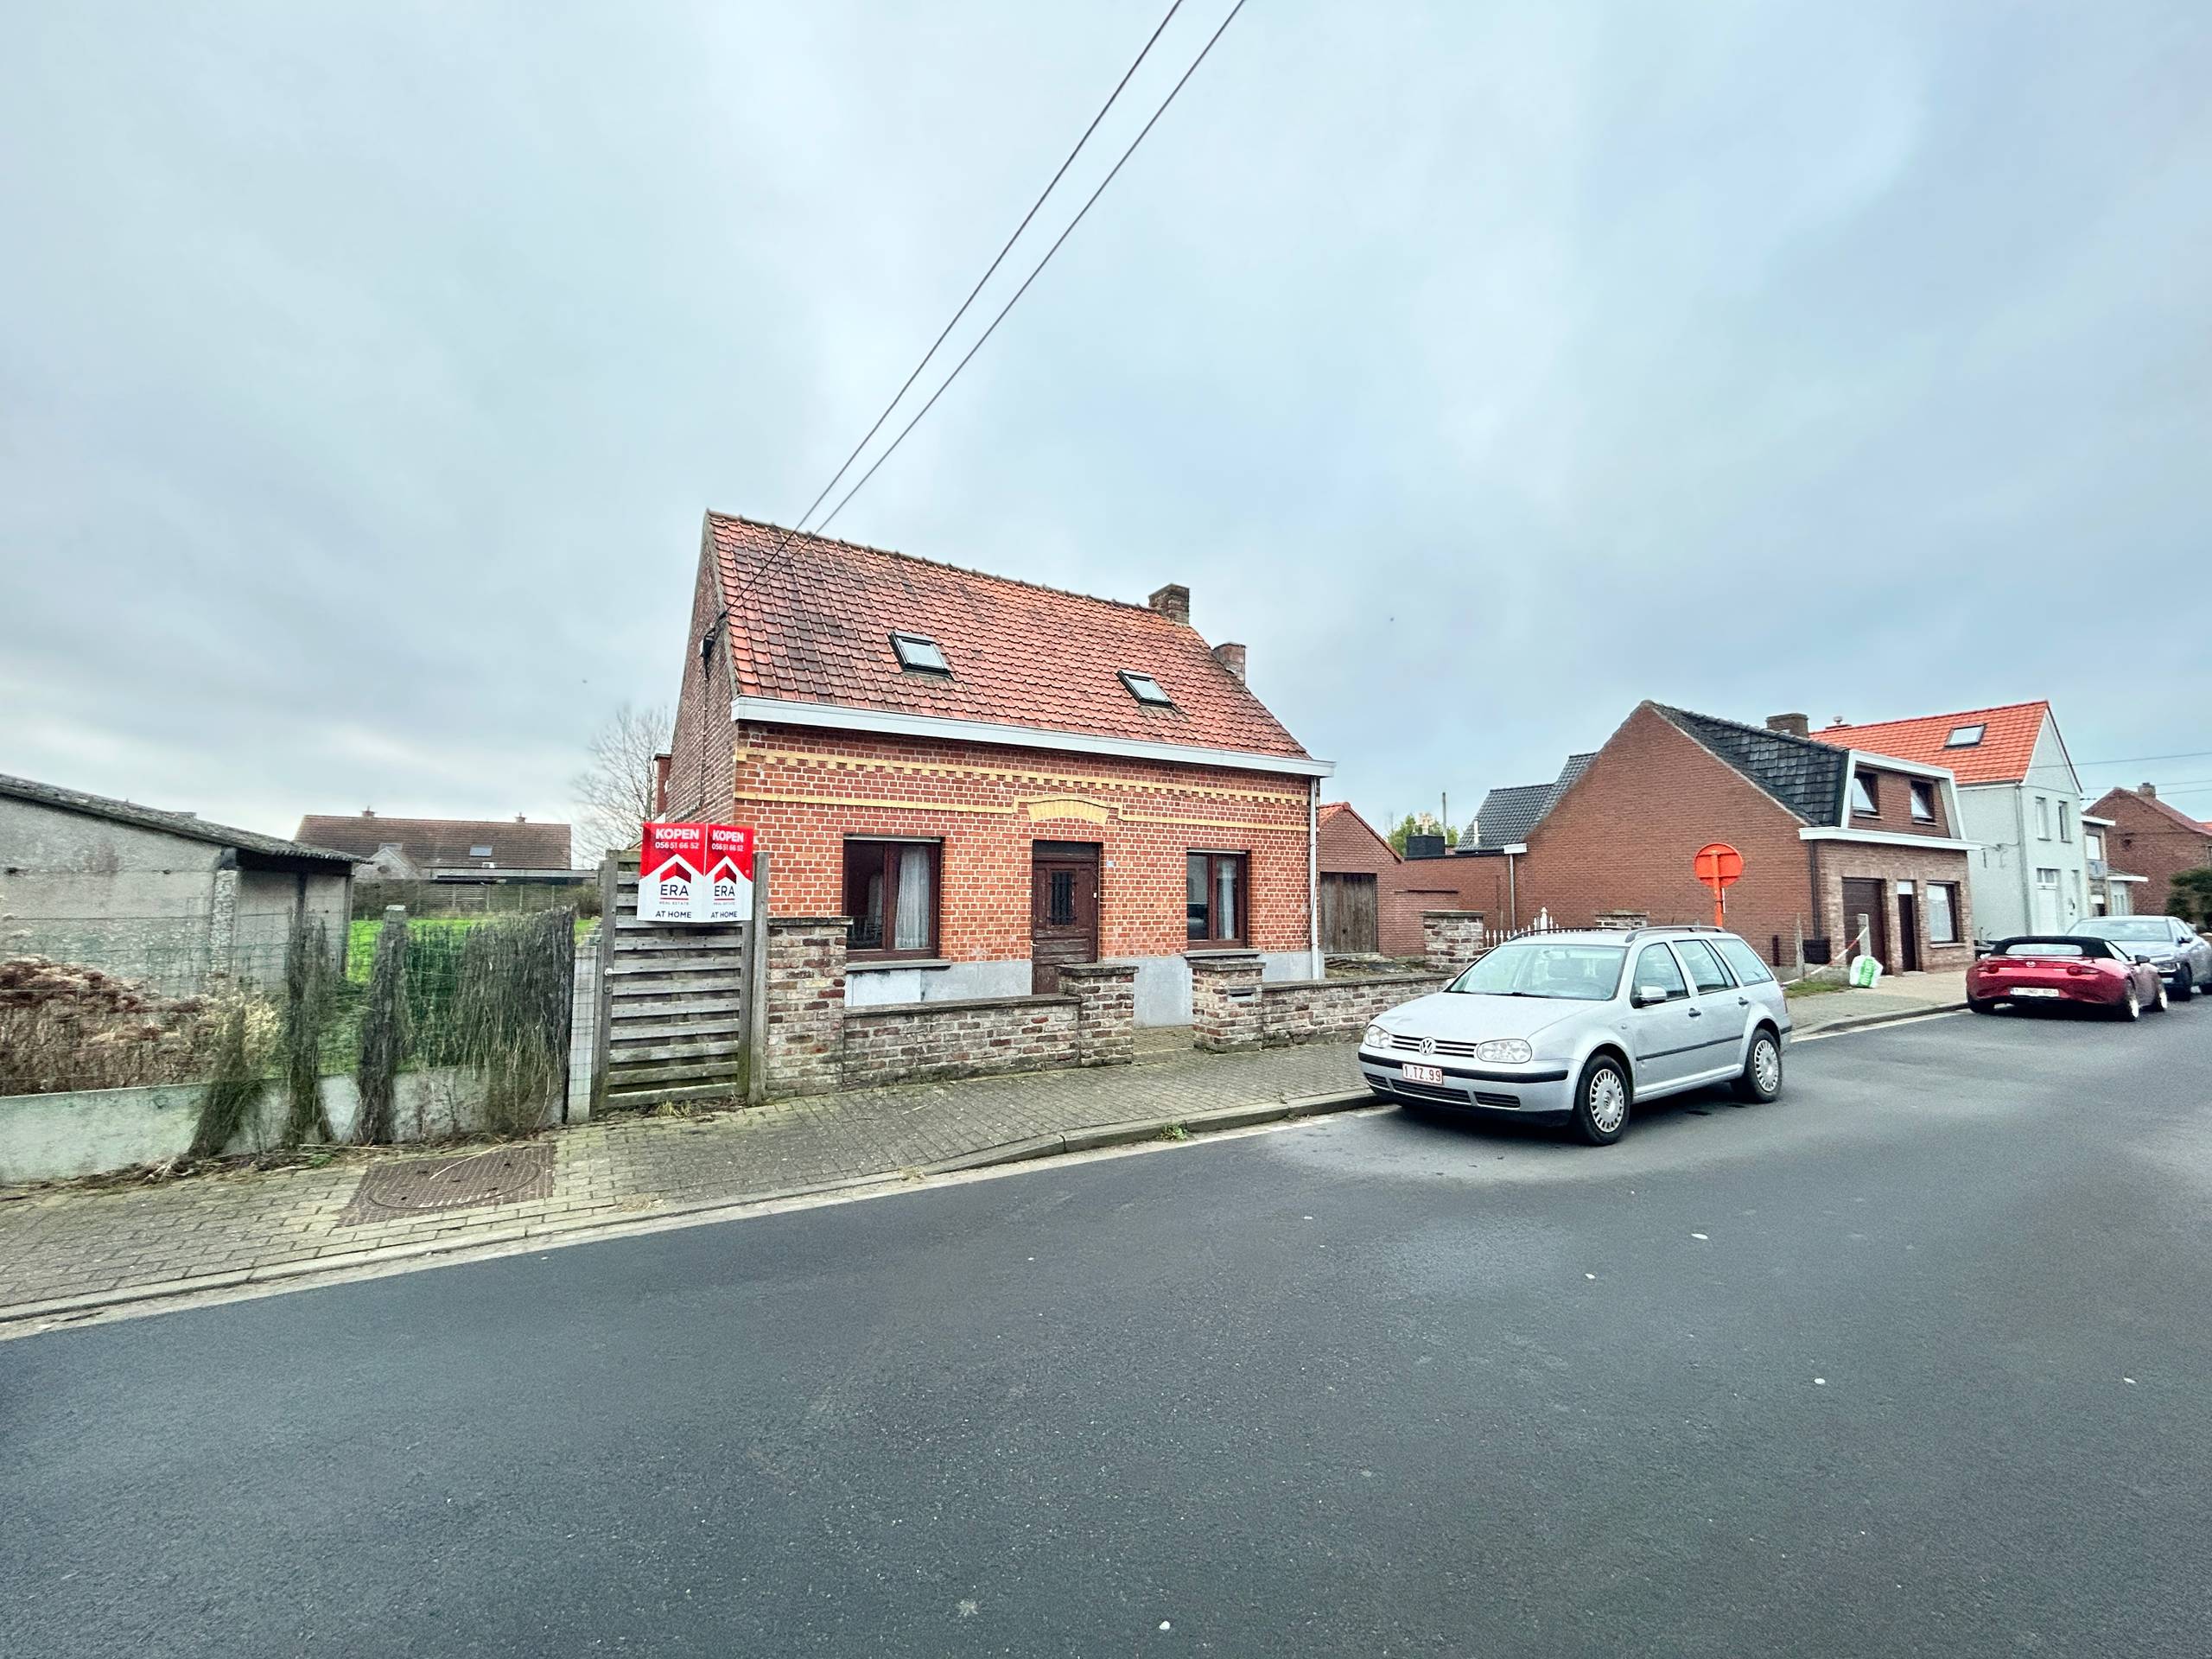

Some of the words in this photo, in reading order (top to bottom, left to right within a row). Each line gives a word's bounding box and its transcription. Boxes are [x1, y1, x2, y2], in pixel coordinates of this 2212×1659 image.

[655, 829, 699, 840] KOPEN
[712, 830, 744, 842] KOPEN
[660, 885, 689, 896] ERA
[714, 886, 735, 897] ERA
